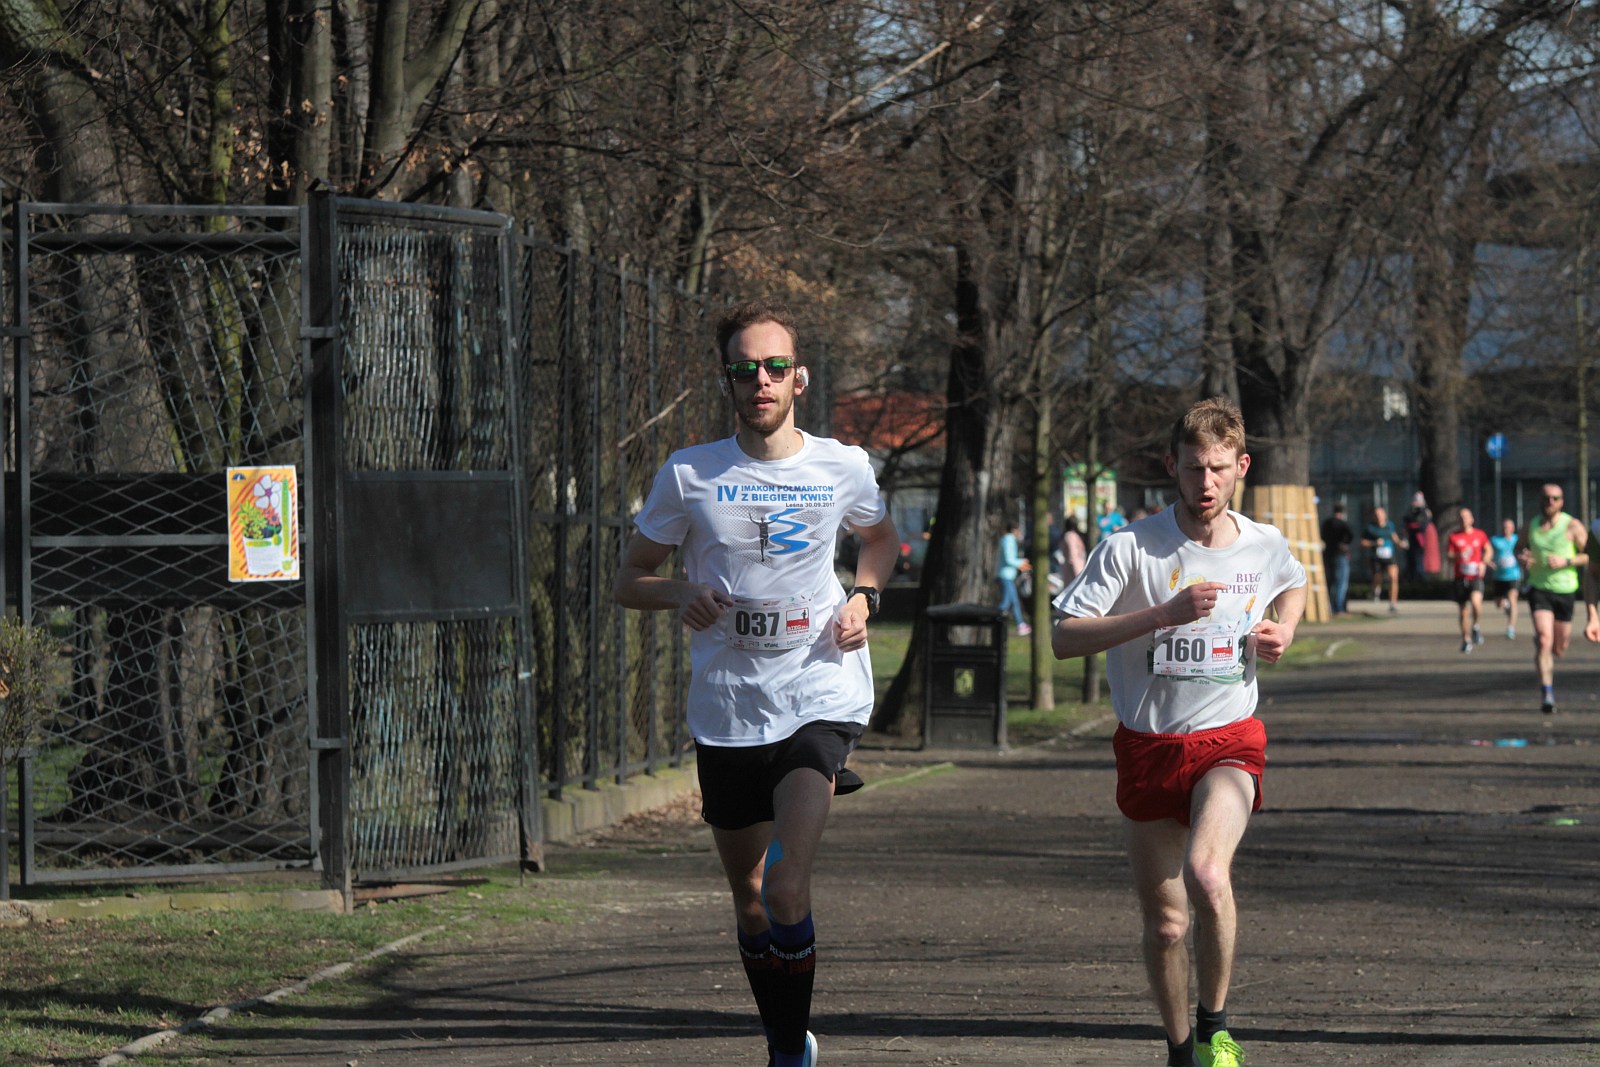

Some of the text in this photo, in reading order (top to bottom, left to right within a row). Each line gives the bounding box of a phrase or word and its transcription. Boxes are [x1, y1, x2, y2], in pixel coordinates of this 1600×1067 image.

[717, 485, 738, 502] IV
[741, 493, 834, 502] Z BIEGIEM KWISY
[1236, 573, 1262, 583] BIEG
[735, 610, 780, 637] 037
[1164, 637, 1206, 663] 160
